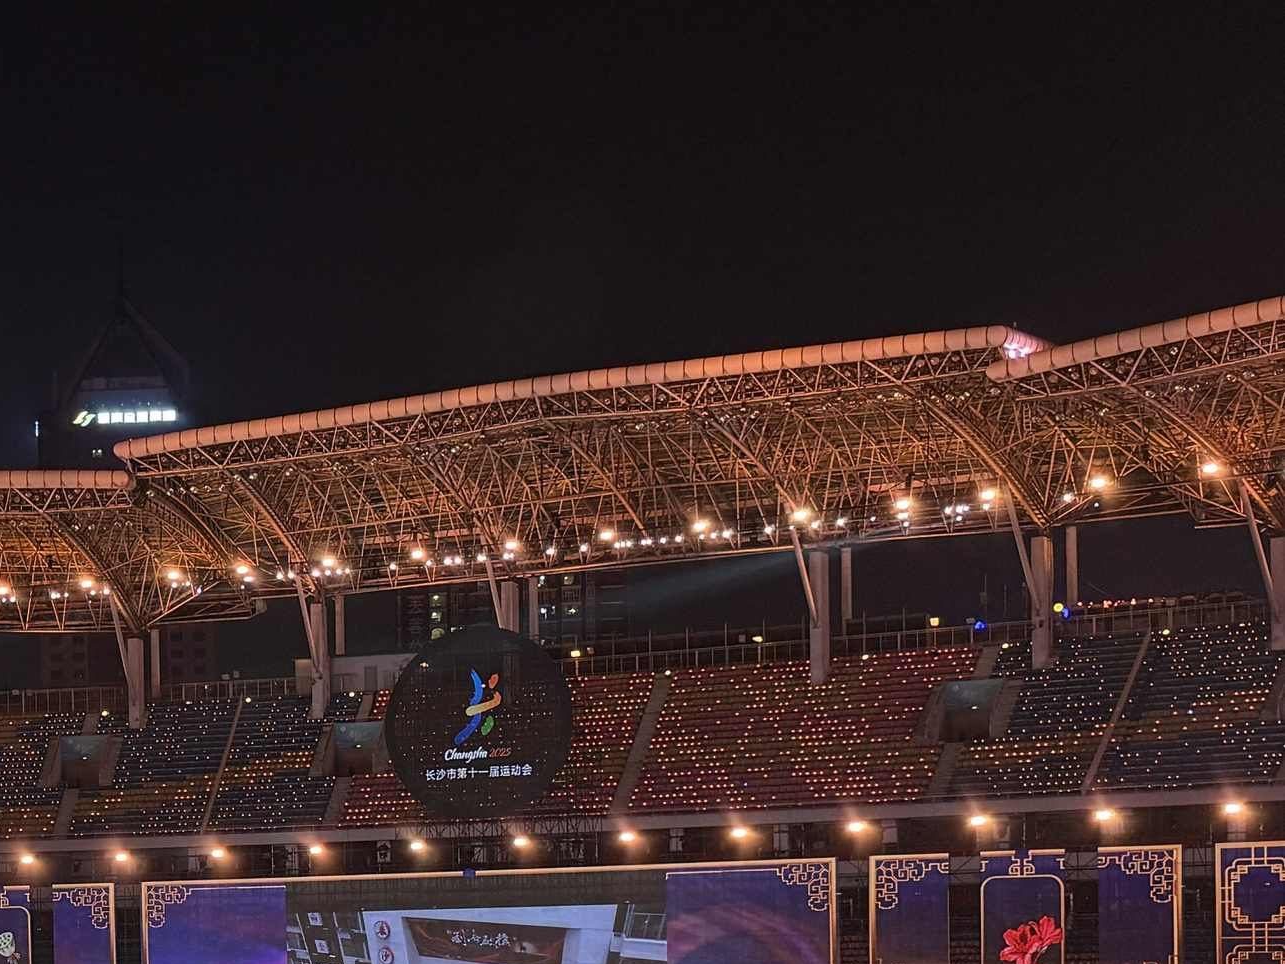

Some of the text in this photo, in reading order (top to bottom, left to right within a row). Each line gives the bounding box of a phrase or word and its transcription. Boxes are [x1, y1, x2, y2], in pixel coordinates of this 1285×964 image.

[444, 746, 512, 764] Changsha 2025
[425, 763, 533, 781] 长沙市第十一届运动会
